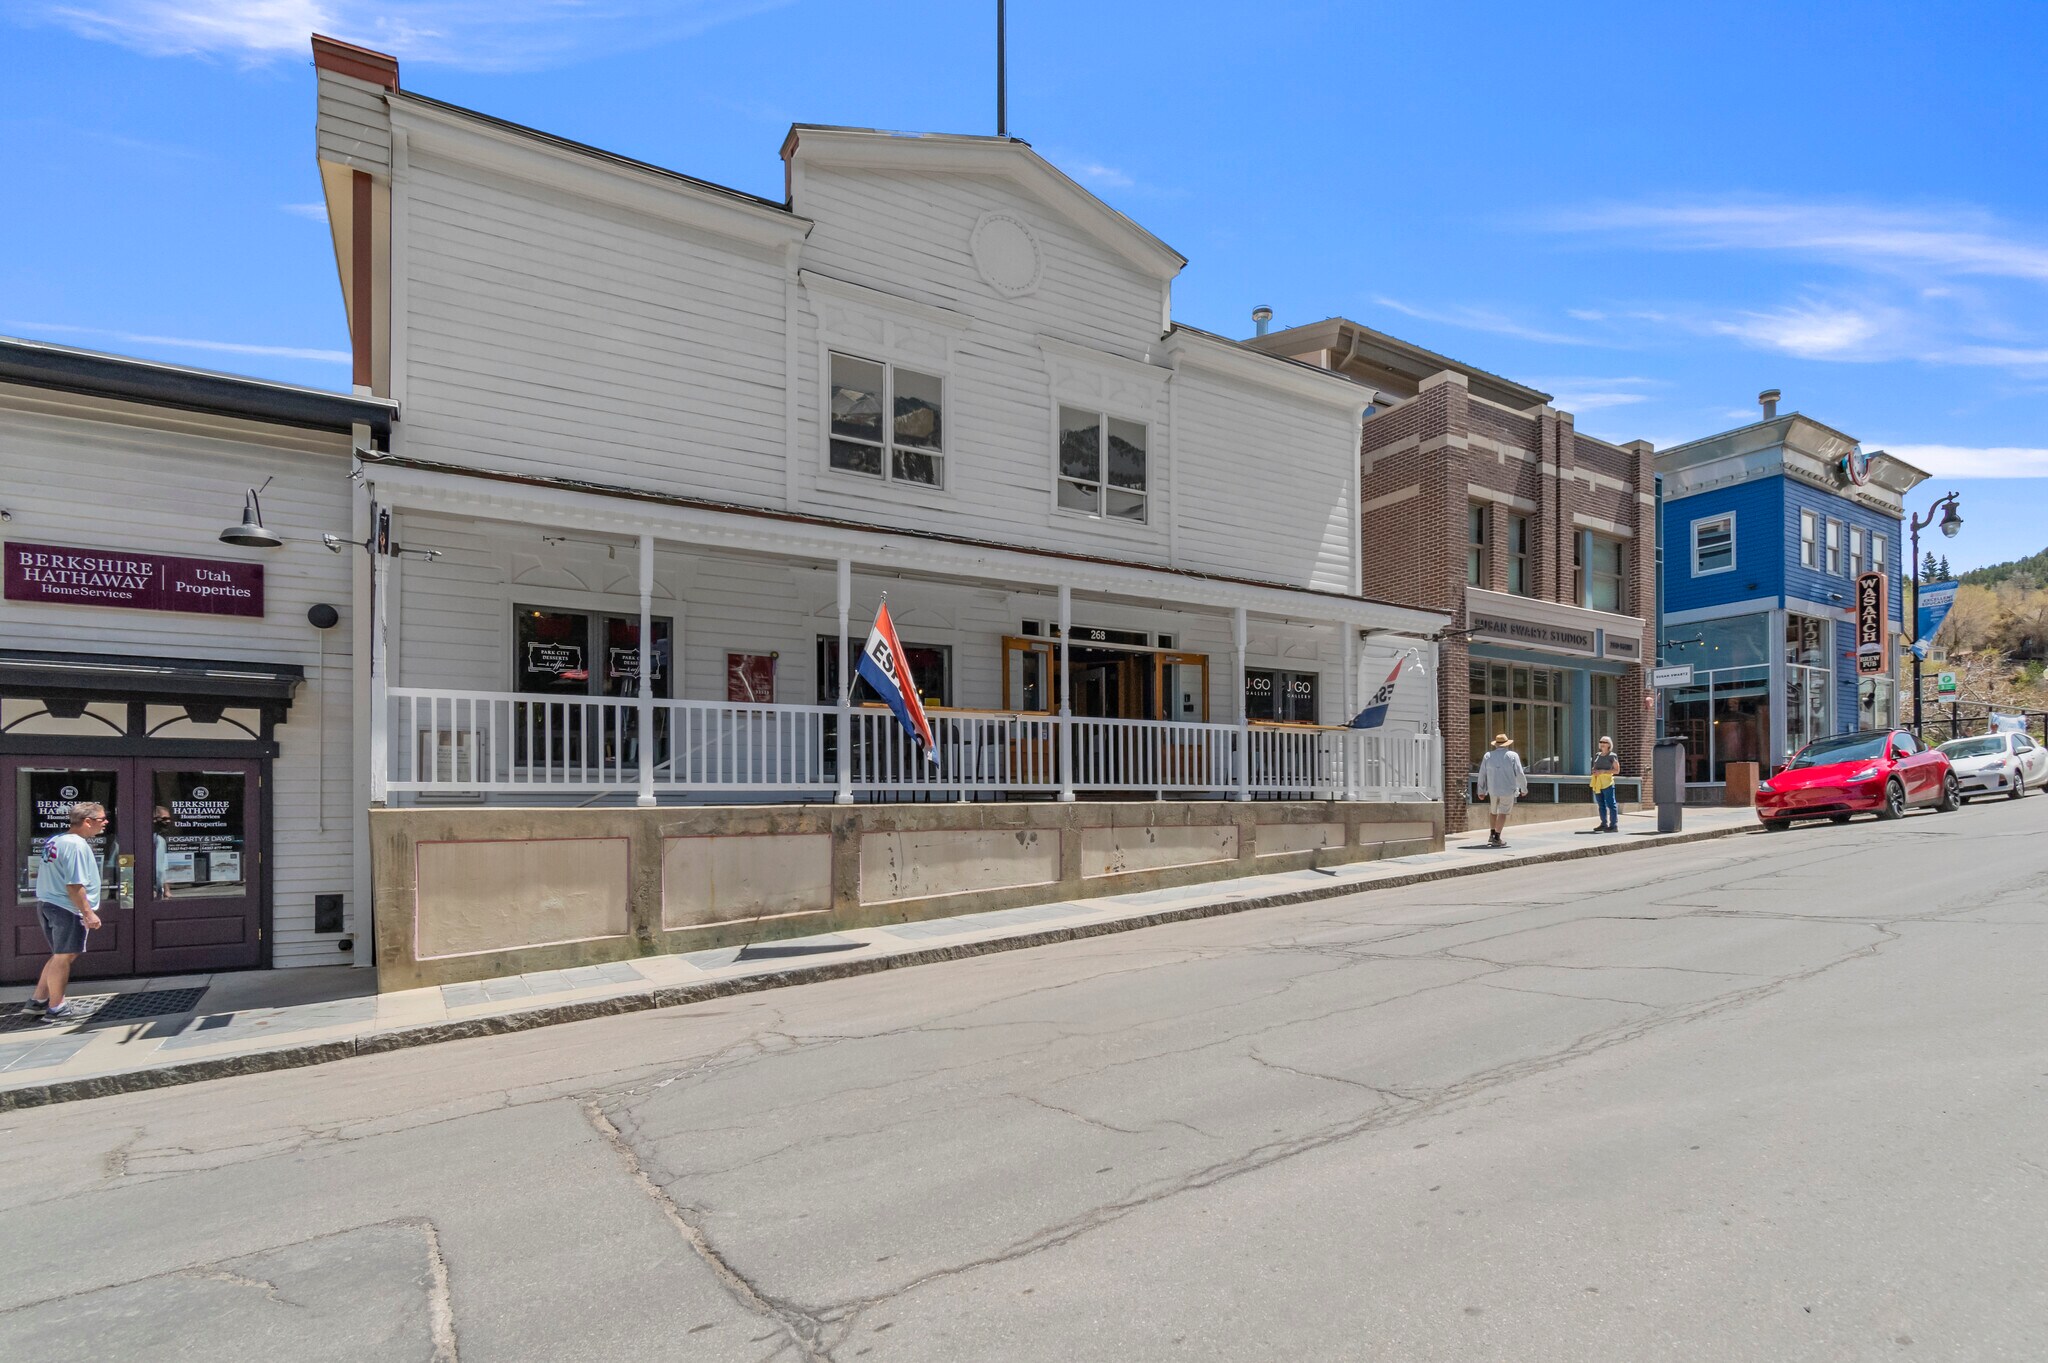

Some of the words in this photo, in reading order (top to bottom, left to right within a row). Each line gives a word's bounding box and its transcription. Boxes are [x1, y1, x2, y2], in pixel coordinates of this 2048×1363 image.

[19, 552, 153, 576] BERKSHIRE
[24, 567, 149, 590] HATHAWAY
[195, 569, 231, 582] Utah
[41, 584, 133, 599] HomeServices
[175, 581, 251, 597] Properties
[1860, 578, 1878, 642] WASATCH
[1090, 629, 1106, 640] 268
[1474, 618, 1507, 633] SUSAN
[1510, 625, 1548, 640] SWARTZ
[1550, 631, 1588, 646] STUDIOS
[173, 807, 228, 815] HATHAWAY
